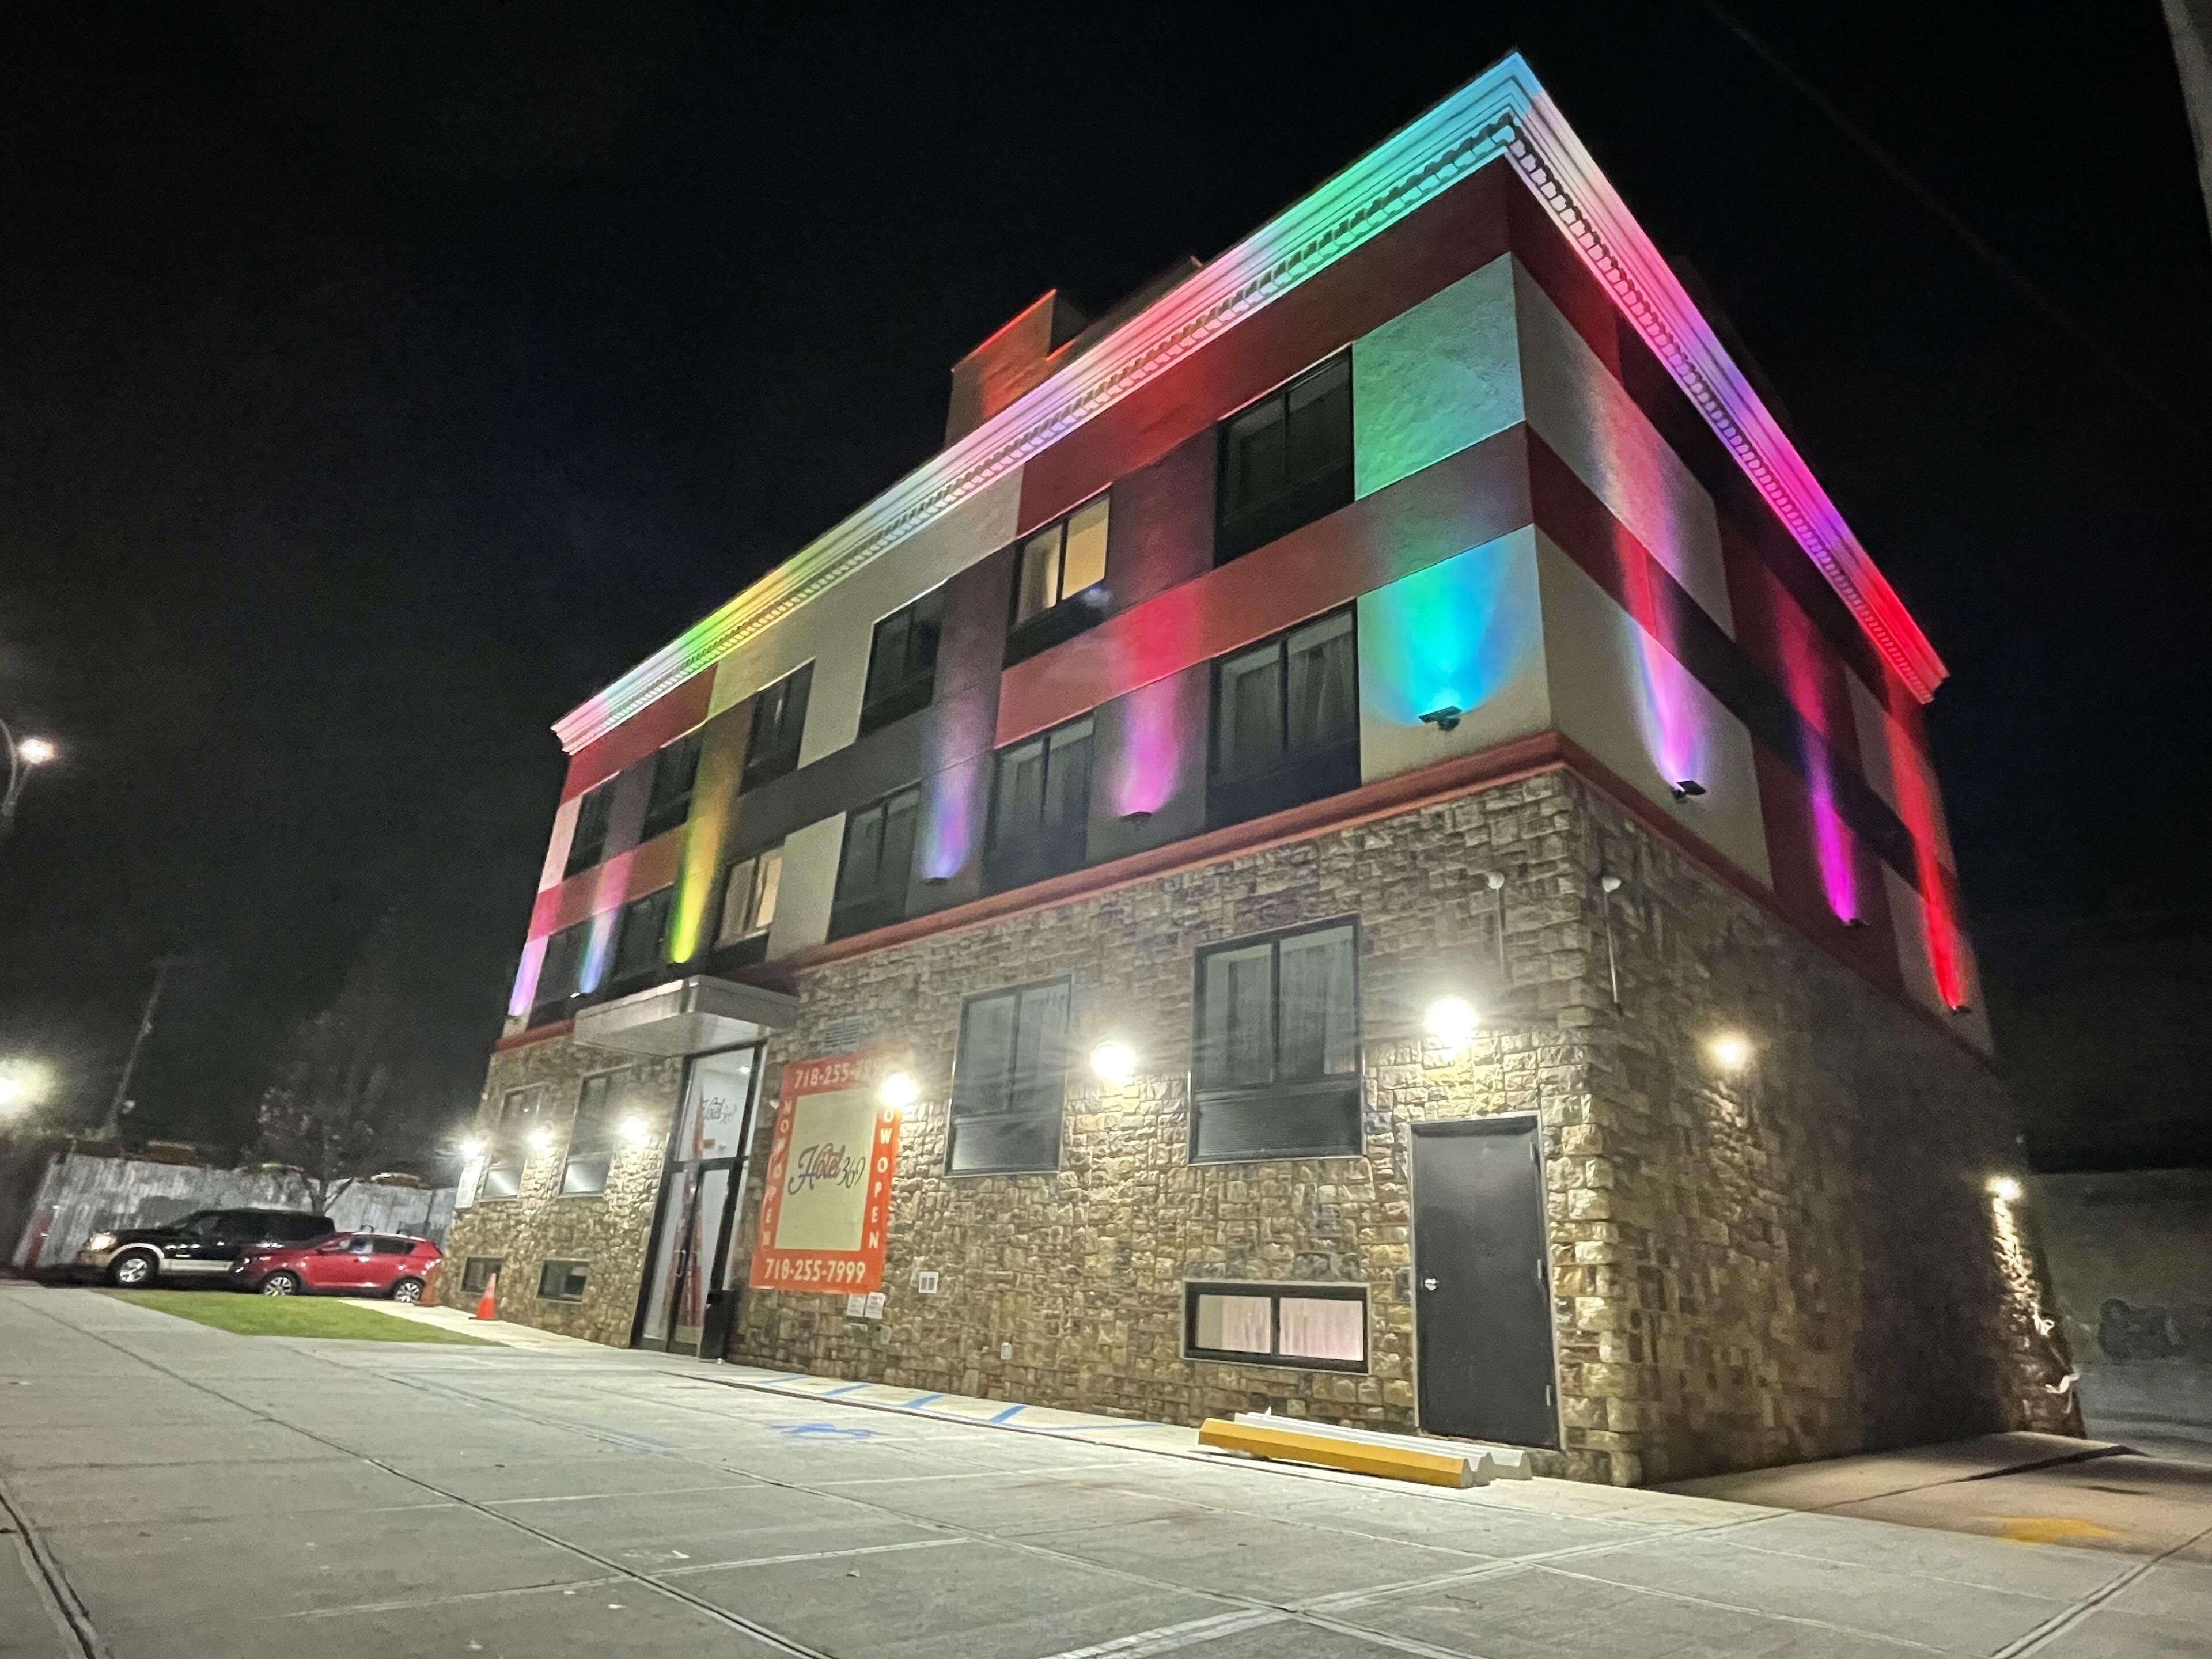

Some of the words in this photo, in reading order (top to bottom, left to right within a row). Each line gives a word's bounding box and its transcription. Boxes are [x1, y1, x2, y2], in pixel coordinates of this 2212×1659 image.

[788, 1142, 846, 1195] Hotel
[869, 1156, 889, 1250] OPEN
[764, 1257, 866, 1284] 718-255-7999
